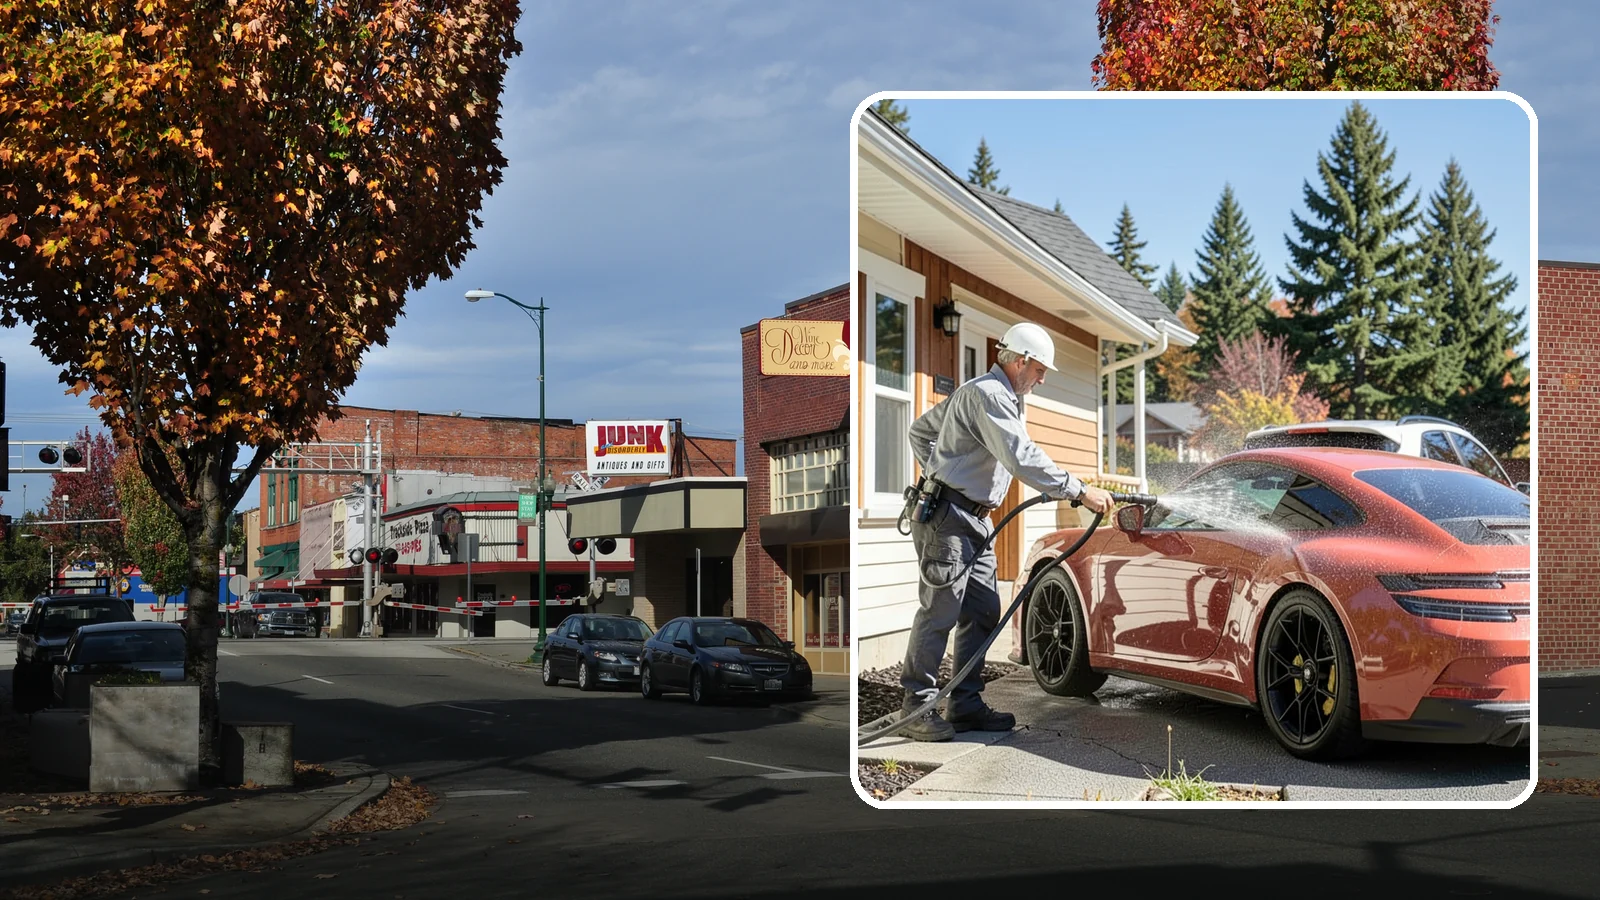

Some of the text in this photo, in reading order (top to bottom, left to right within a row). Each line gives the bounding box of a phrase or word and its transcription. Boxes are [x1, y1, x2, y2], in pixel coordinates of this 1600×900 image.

[596, 425, 664, 457] JUNK
[607, 446, 645, 454] DISORDERLY
[597, 460, 665, 470] ANTIQUES AND GIFTS
[414, 520, 429, 535] Pizza
